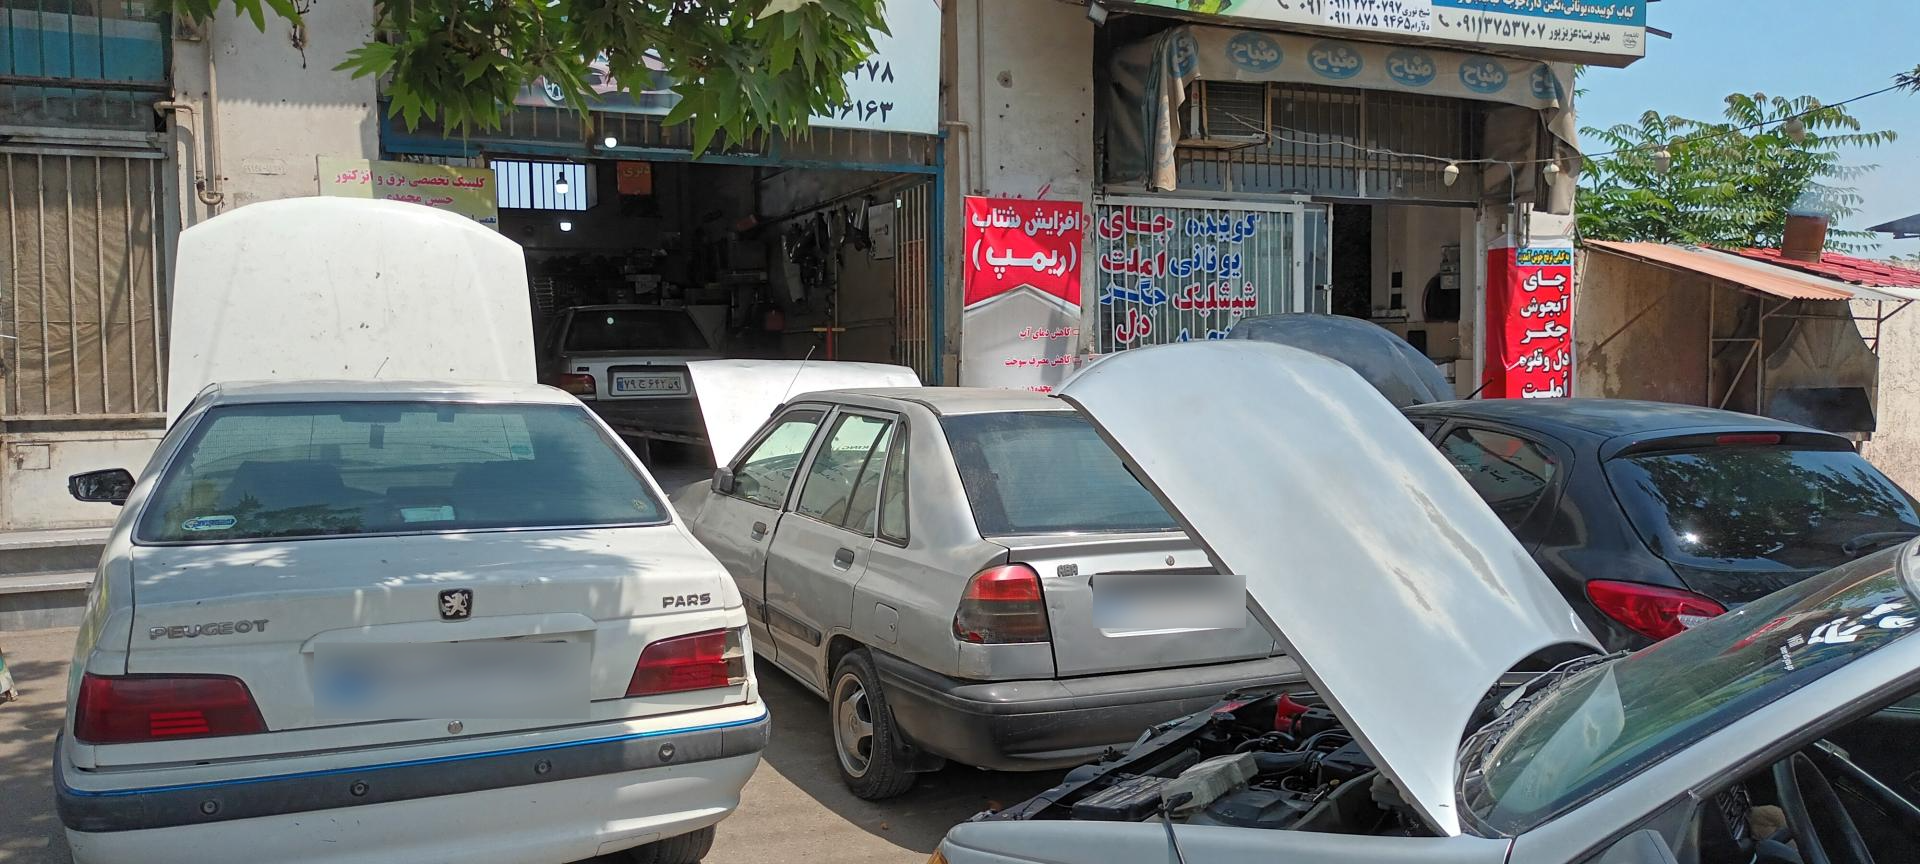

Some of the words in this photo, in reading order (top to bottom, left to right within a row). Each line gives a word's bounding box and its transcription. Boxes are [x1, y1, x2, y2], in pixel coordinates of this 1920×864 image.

[1329, 10, 1350, 25] ۰۹۱۱
[1356, 13, 1378, 27] ۸۷۵
[1383, 14, 1410, 30] ۹۴۶۵
[1456, 14, 1546, 40] ۰۹۱۱۳۷۵۳۷۰۷
[376, 175, 384, 186] و
[386, 172, 406, 187] برق
[408, 174, 450, 188] تخصصی
[971, 205, 1021, 233] شتاب
[1024, 207, 1080, 237] افزایش
[1098, 205, 1176, 246] چای
[1100, 247, 1167, 279] املت
[1169, 243, 1243, 278] یونانی
[1522, 268, 1567, 292] چای
[1099, 278, 1169, 318] جگر
[1172, 281, 1258, 318] شیشلیک
[1520, 294, 1569, 318] آبجوش
[1050, 326, 1071, 340] کاهش
[1115, 307, 1153, 344] دل
[1520, 320, 1568, 345] جگر
[1050, 353, 1071, 368] کاهش
[1553, 348, 1570, 371] دل
[662, 592, 711, 609] PARS
[149, 618, 270, 641] PEUGEOT
